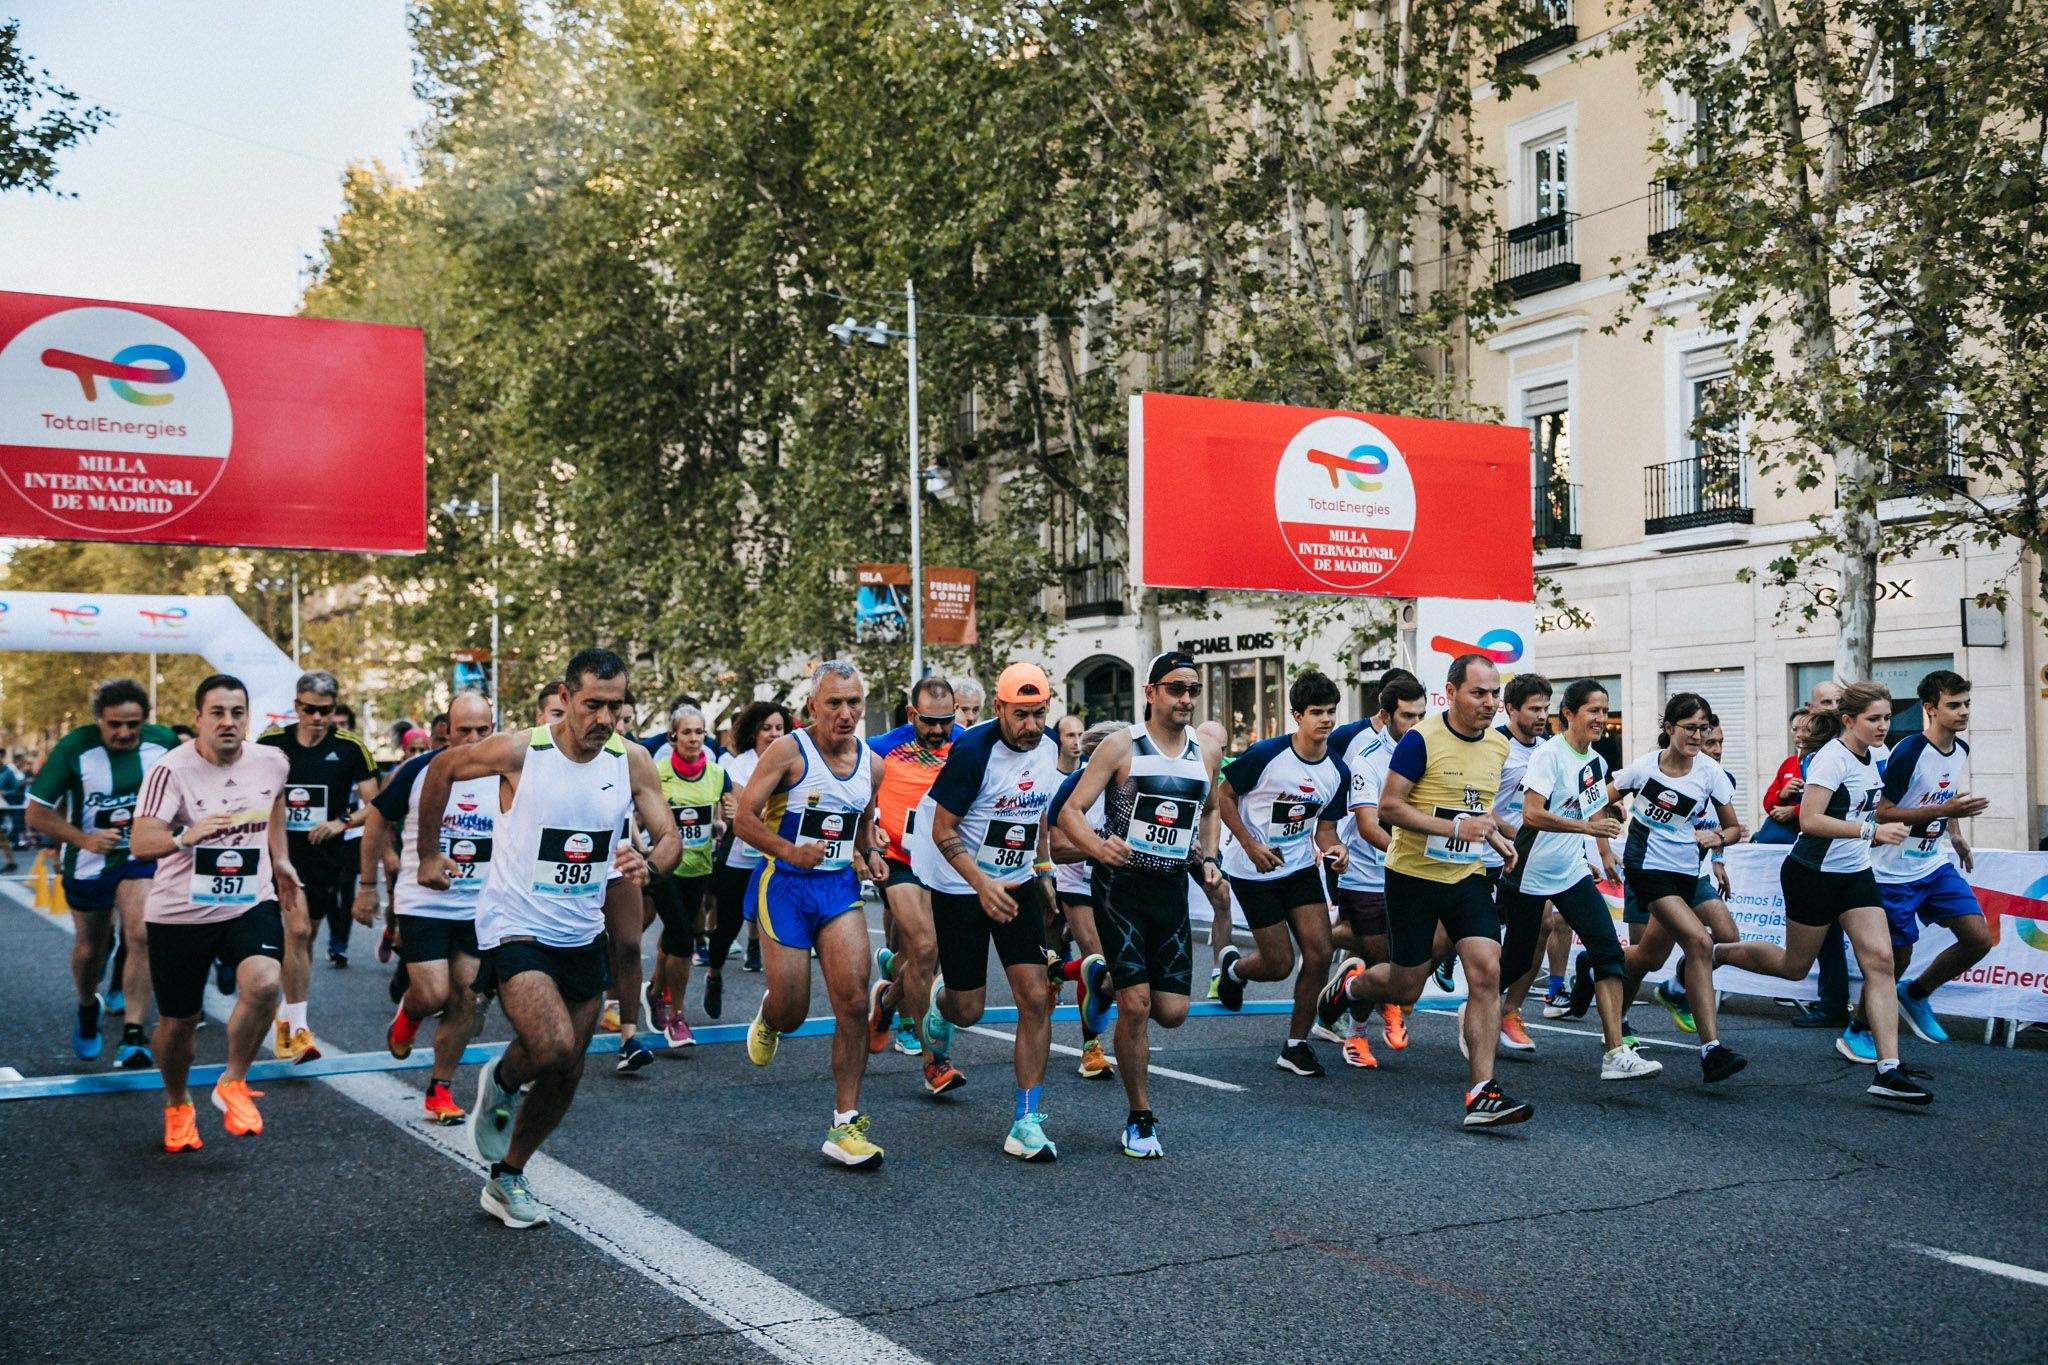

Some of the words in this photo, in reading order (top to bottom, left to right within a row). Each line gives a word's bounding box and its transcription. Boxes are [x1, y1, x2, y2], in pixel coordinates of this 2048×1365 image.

[41, 413, 188, 439] TotalEnergies
[78, 455, 147, 474] MILLA
[52, 494, 84, 510] DE
[87, 495, 173, 514] MADRID
[1308, 498, 1391, 517] TotalEnergies
[1328, 529, 1369, 544] MILLA
[1313, 558, 1331, 571] DE
[1334, 559, 1383, 574] MADRID
[1178, 637, 1233, 655] MICHAEL
[1237, 632, 1275, 651] KORS
[1644, 803, 1673, 823] 399
[1145, 825, 1178, 845] 390
[1282, 821, 1306, 836] 364
[995, 848, 1025, 867] 384
[554, 863, 592, 884] 393
[211, 877, 244, 894] 357
[1740, 931, 1781, 944] arreras
